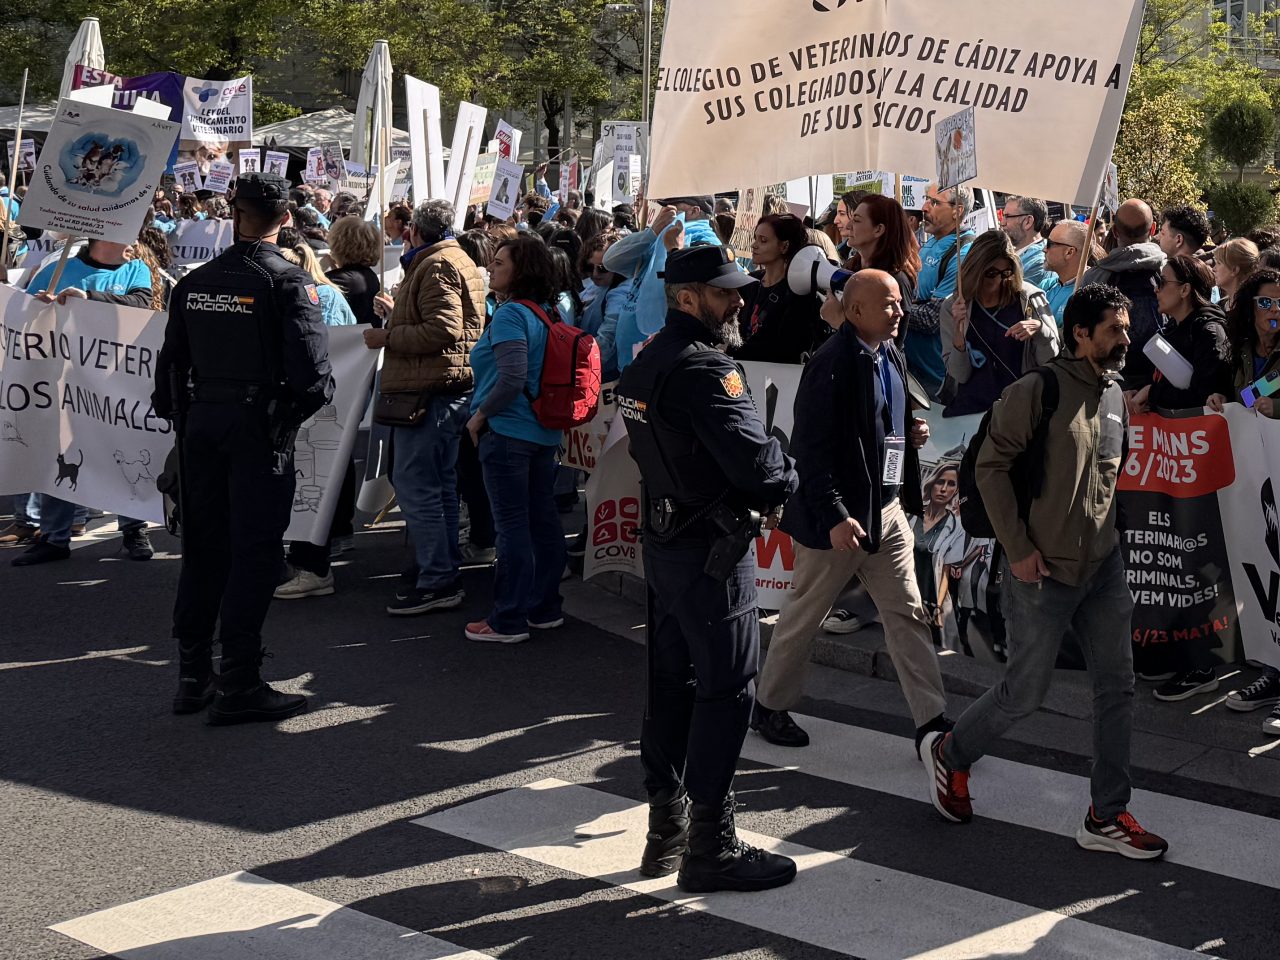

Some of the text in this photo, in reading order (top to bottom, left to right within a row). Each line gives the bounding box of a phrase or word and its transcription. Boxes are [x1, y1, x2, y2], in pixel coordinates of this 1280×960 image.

[657, 67, 671, 91] EL
[673, 66, 741, 93] COLEGIO
[751, 57, 783, 84] DE
[917, 36, 949, 64] DE
[954, 39, 1021, 74] CÁDIZ
[1023, 52, 1098, 86] APOYA
[1104, 63, 1122, 90] A
[81, 67, 123, 89] ESTA
[704, 67, 1028, 125] SUS COLEGIADOS Y LA CALIDAD
[190, 115, 247, 125] MEDICAMENTO
[201, 107, 231, 116] LEY DEL
[800, 110, 821, 138] DE
[825, 103, 863, 131] SUS
[872, 101, 936, 134] SCIOS
[193, 125, 244, 135] VETERINARIO
[43, 164, 59, 196] Cuidando
[58, 194, 67, 203] de
[78, 203, 101, 213] salud
[102, 197, 140, 213] cuidamos
[186, 302, 253, 314] NACIONAL
[187, 293, 240, 304] POLICIA
[1152, 426, 1210, 457] MANS
[1122, 452, 1198, 486] 6/2023
[1148, 511, 1171, 527] ELS
[1125, 529, 1208, 553] TERINARI@S
[594, 545, 636, 560] COVB
[1129, 550, 1183, 570] NO SOM
[1123, 569, 1200, 589] RIMINALS,
[1167, 583, 1219, 608] VIDES!
